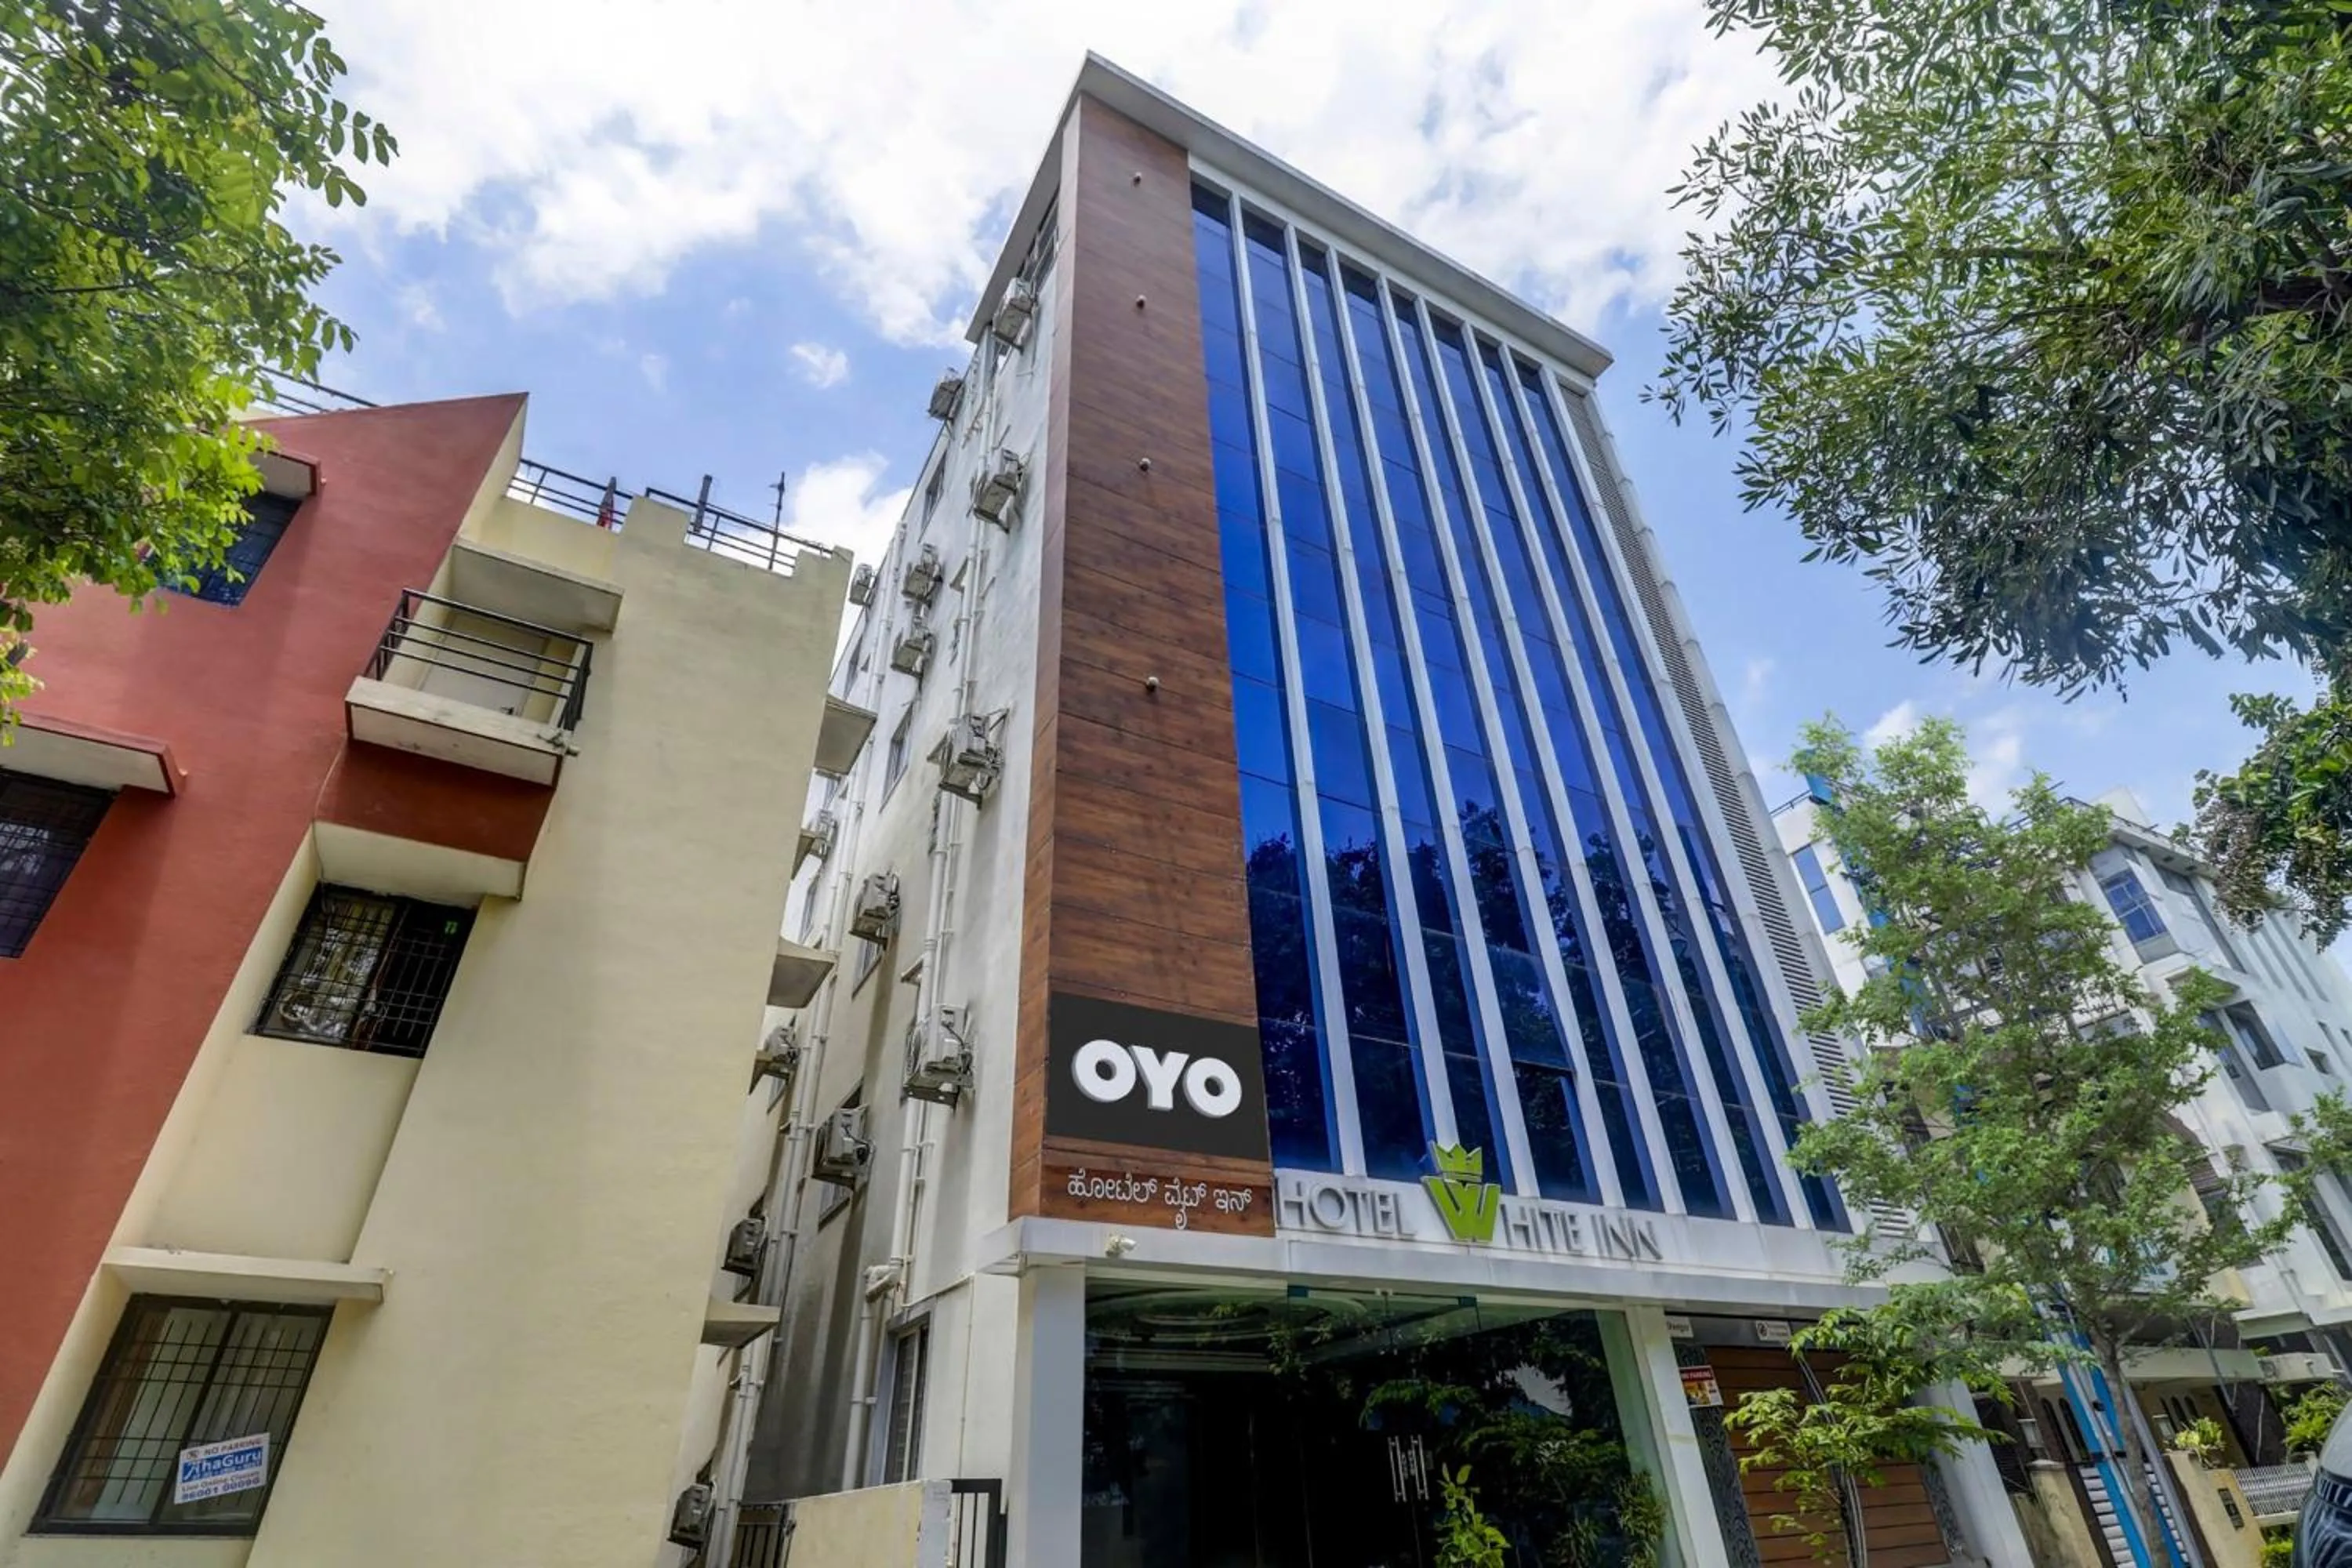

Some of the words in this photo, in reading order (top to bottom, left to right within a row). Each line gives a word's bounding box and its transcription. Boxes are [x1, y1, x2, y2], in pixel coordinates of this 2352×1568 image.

[1072, 1039, 1242, 1118] OYO
[1067, 1167, 1158, 1203] ಹೋಟೆಲ್
[1214, 1188, 1252, 1214] ಇನ್
[1274, 1177, 1417, 1238] HOTEL
[1591, 1214, 1664, 1261] INN
[205, 1446, 219, 1455] NO
